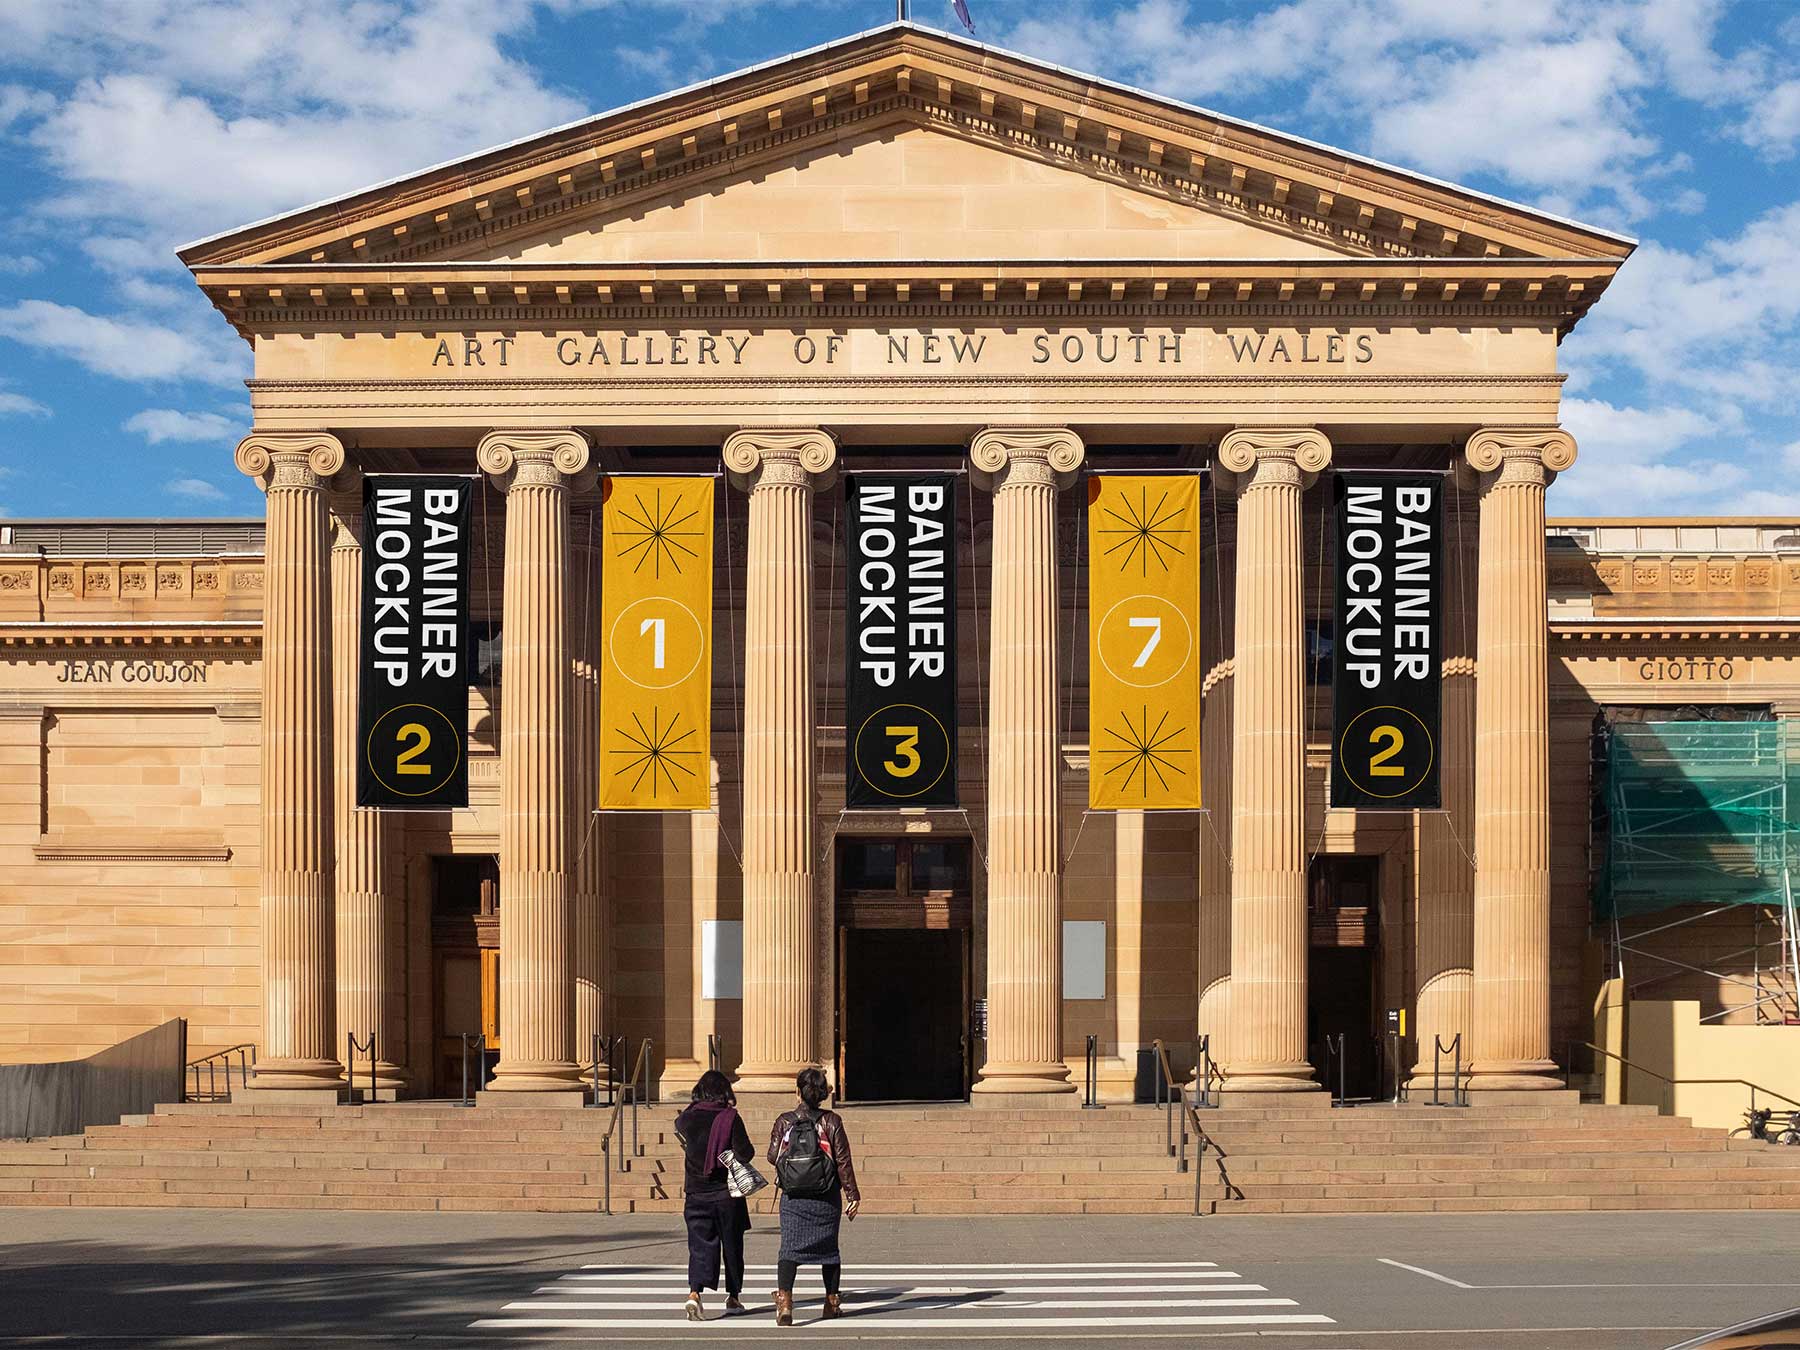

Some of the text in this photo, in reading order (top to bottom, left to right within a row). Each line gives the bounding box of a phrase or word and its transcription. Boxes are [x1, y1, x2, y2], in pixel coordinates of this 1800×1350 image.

[432, 334, 1374, 366] ART GALLERY OF NEW SOUTH WALES
[373, 488, 412, 687] MOCKUP
[422, 489, 459, 679] BANNER
[859, 486, 896, 687] MOCKUP
[908, 485, 945, 679] BANNER
[1345, 486, 1382, 689] MOCKUP
[1394, 487, 1431, 681] BANNER
[640, 618, 665, 669] 1
[1129, 617, 1161, 668] 7
[57, 664, 207, 683] JEAN GOUJON
[1639, 662, 1734, 681] GIOTTO
[396, 723, 432, 775] 2
[883, 725, 921, 778] 3
[1369, 725, 1405, 777] 2
